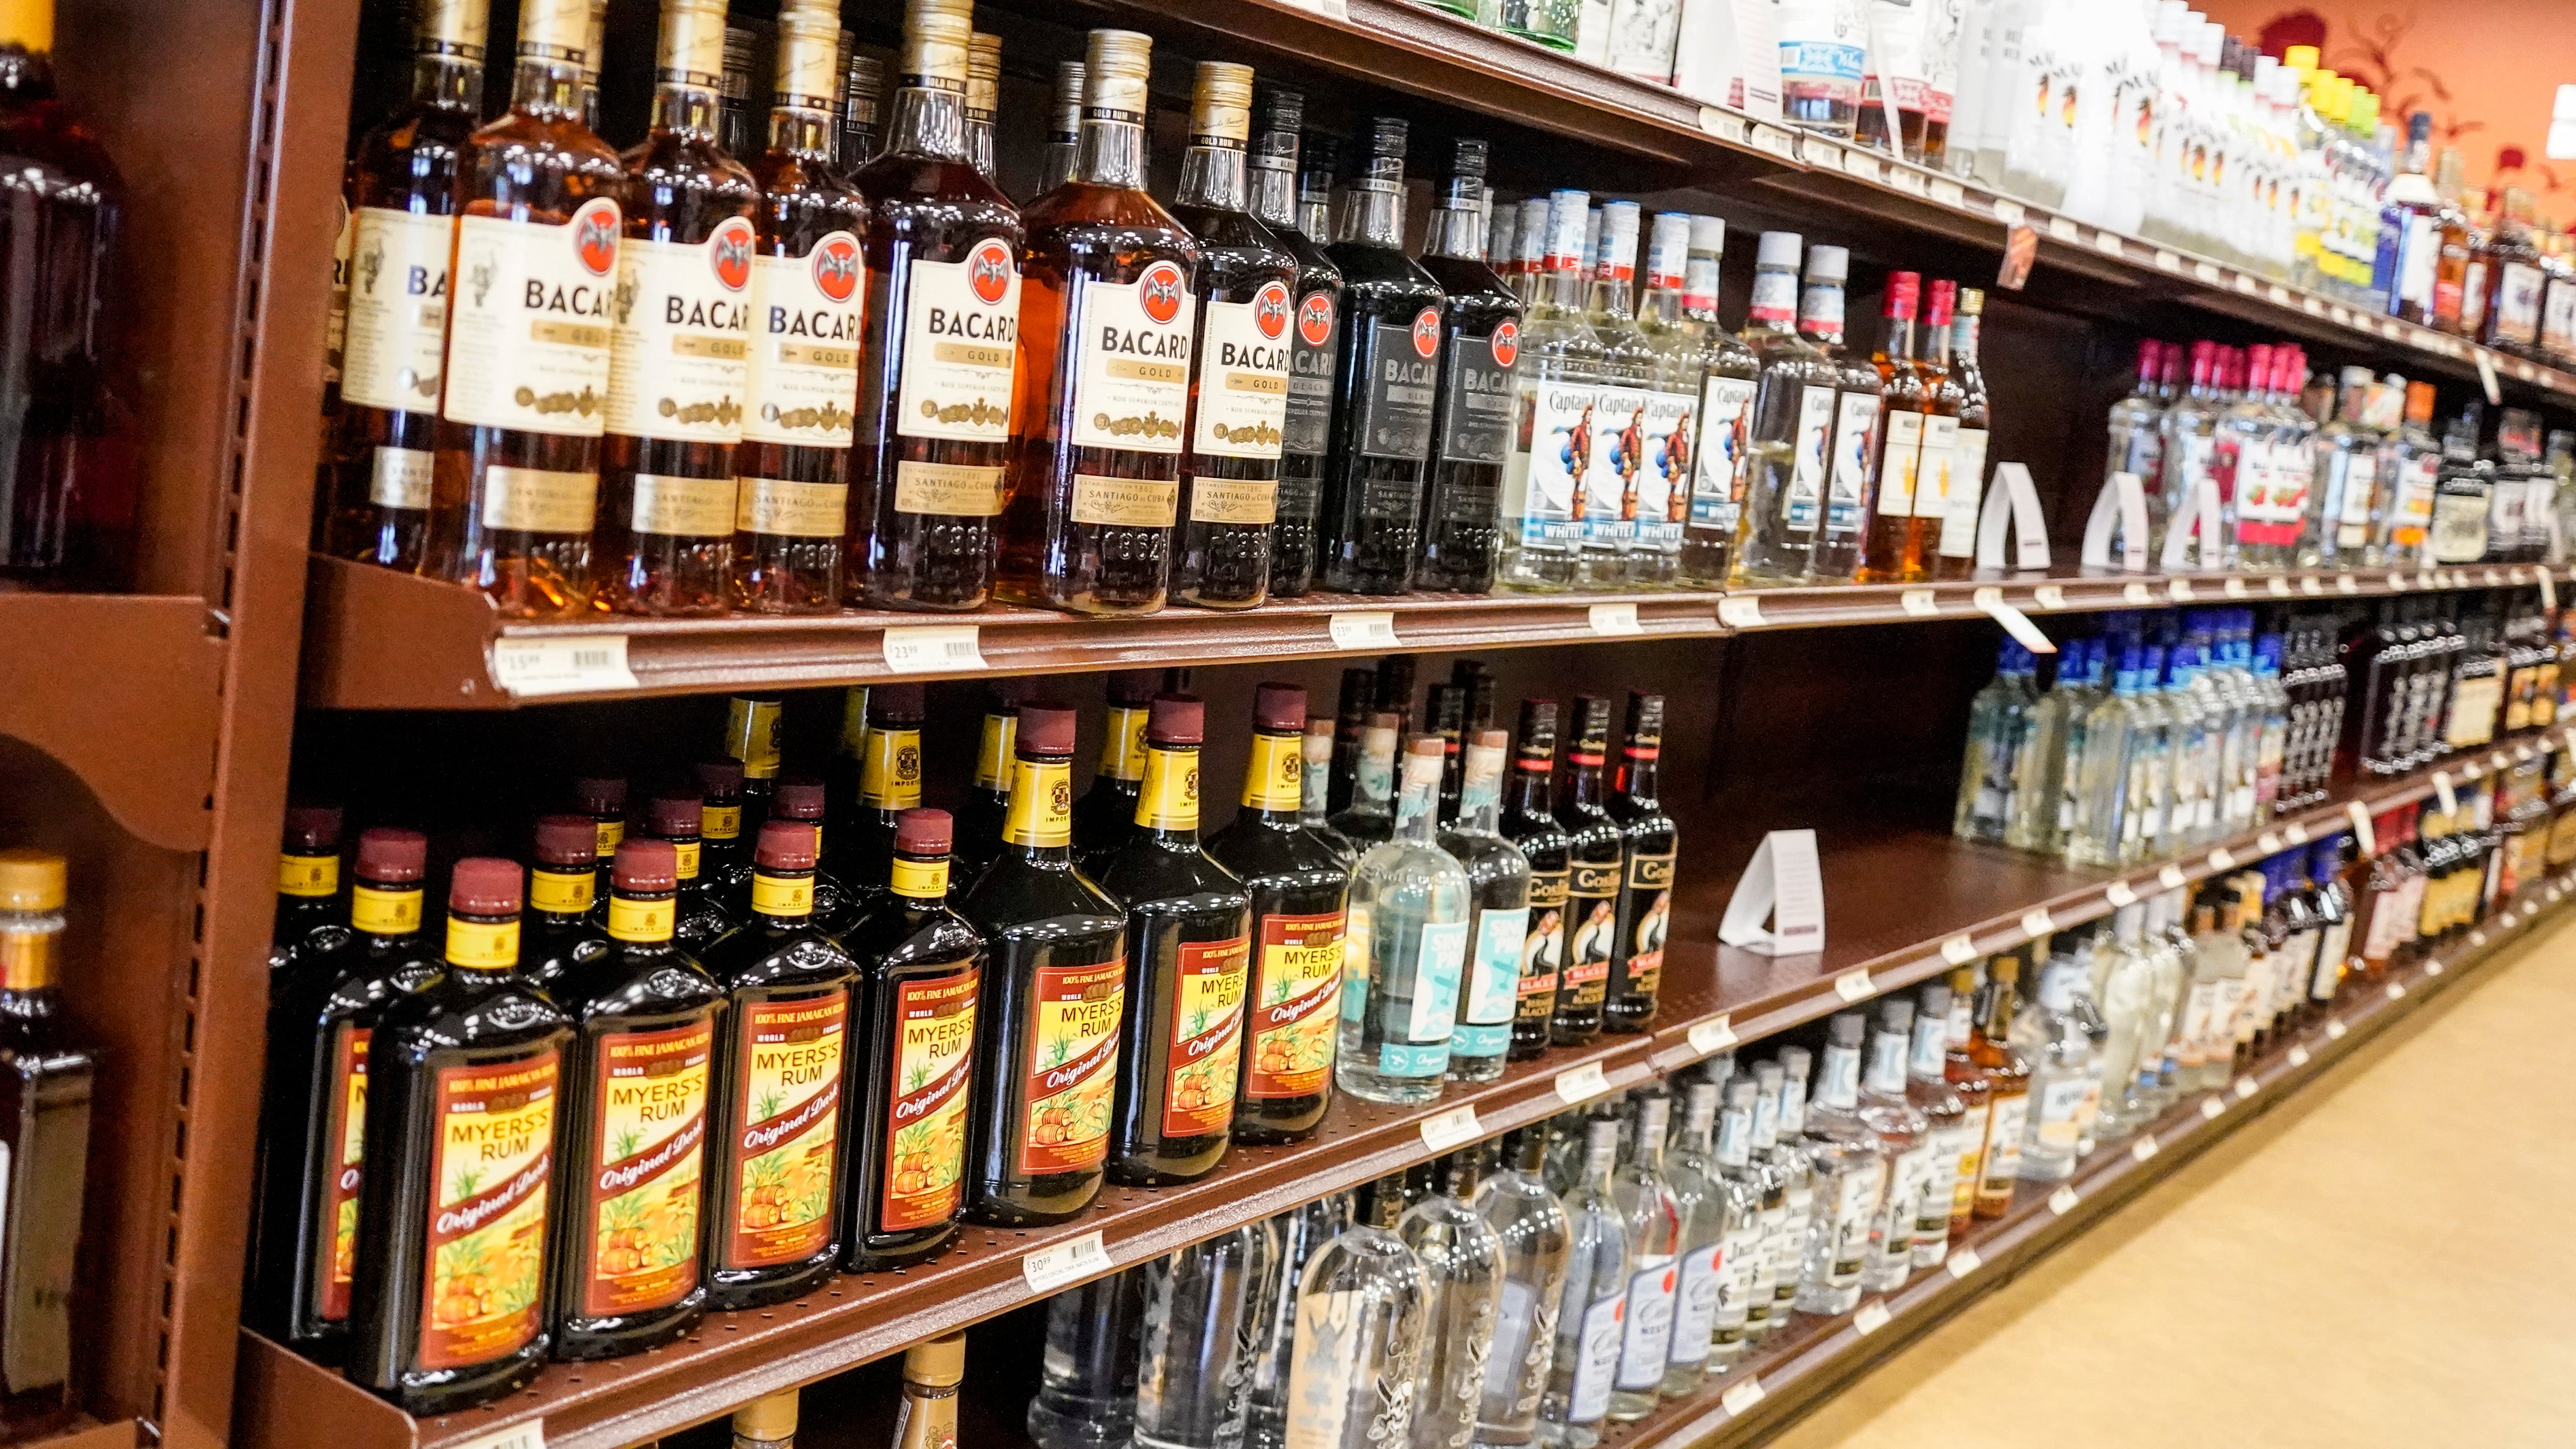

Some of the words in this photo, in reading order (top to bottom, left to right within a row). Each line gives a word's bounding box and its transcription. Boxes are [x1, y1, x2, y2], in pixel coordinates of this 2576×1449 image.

[1093, 108, 1111, 118] GOLD
[1113, 110, 1128, 120] RUM
[1219, 139, 1233, 147] RUM
[813, 350, 850, 364] GOLD
[968, 350, 999, 362] GOLD
[1139, 367, 1171, 378] GOLD
[1253, 379, 1278, 389] GOLD
[915, 477, 966, 489] SANTIAGO
[975, 481, 992, 489] CUBA
[1135, 485, 1154, 493] 1862
[1089, 490, 1138, 501] SANTIAGO
[1147, 494, 1165, 503] CUBA
[1207, 491, 1251, 501] SANTIAGO
[1285, 922, 1301, 931] 100%
[1301, 921, 1314, 930] FINE
[1303, 963, 1332, 979] RUM
[1063, 975, 1079, 986] 100%
[1080, 974, 1094, 984] FINE
[907, 990, 926, 1002] 100%
[927, 987, 942, 1000] FINE
[1218, 989, 1242, 1008] RUM
[909, 1009, 933, 1018] WORLD
[1270, 991, 1322, 1023] Original
[754, 1013, 776, 1025] 100%
[777, 1011, 796, 1024] FINE
[796, 1005, 832, 1023] JAMAICAN
[1080, 1020, 1111, 1038] RUM
[1188, 1015, 1234, 1057] Original
[929, 1039, 961, 1060] RUM
[781, 1064, 823, 1087] RUM
[1047, 1053, 1102, 1089] Original
[896, 1080, 952, 1119] Original
[640, 1100, 685, 1123] RUM
[744, 1107, 810, 1150] Original
[809, 1080, 838, 1118] Dark
[480, 1134, 530, 1162] RUM
[600, 1146, 671, 1191] Original
[671, 1117, 704, 1157] Dark
[436, 1185, 517, 1234] Original
[1031, 1273, 1048, 1283] MYERS
